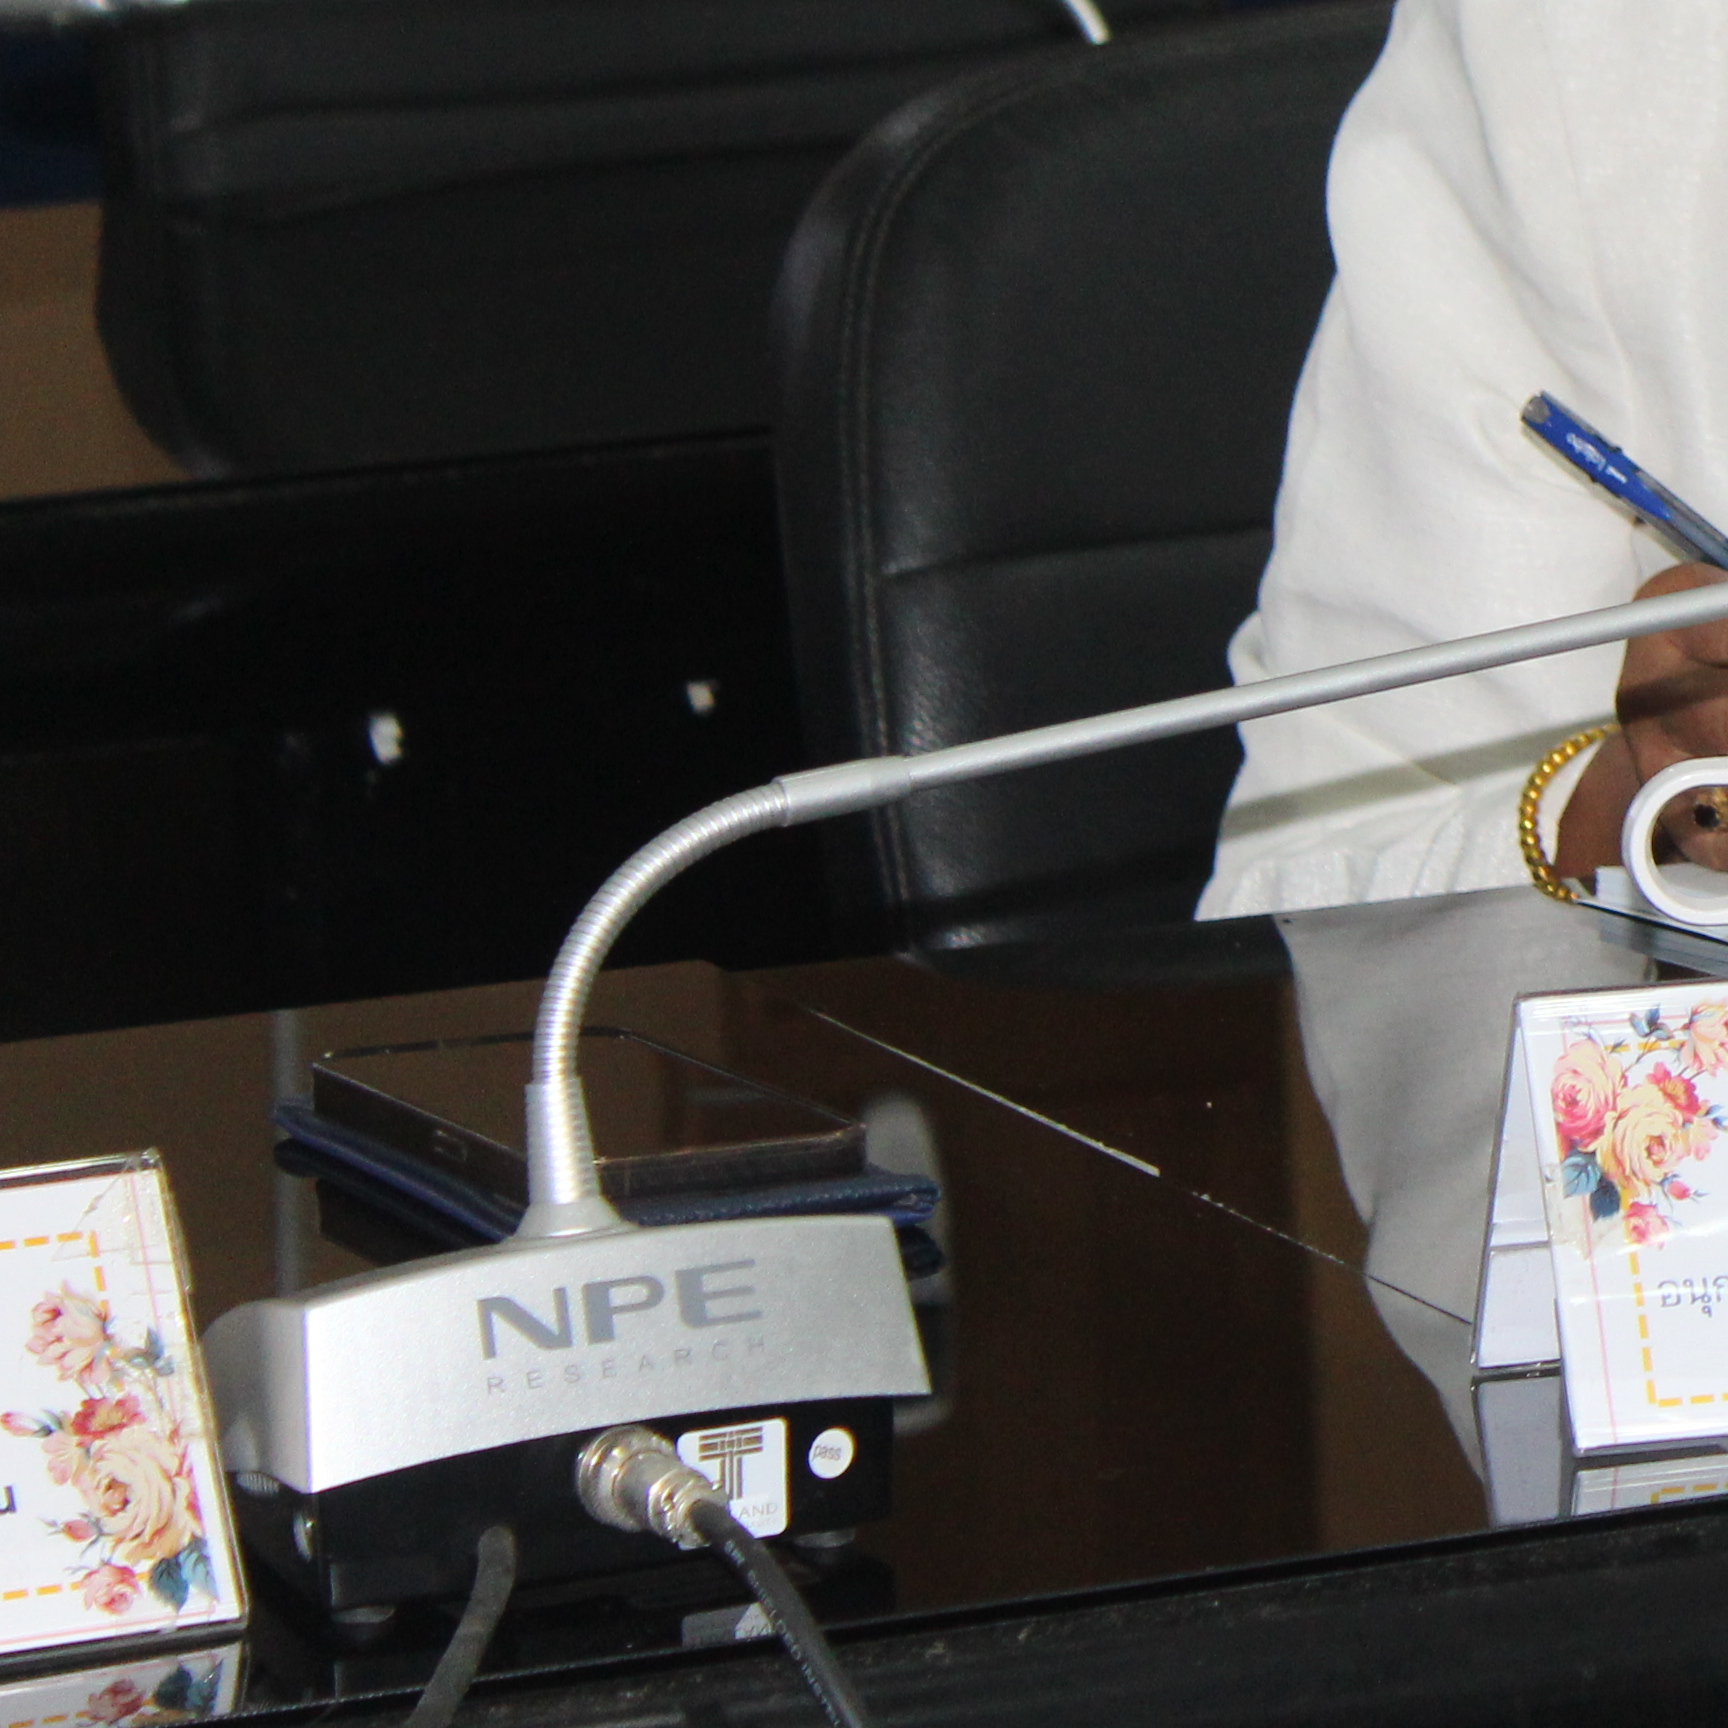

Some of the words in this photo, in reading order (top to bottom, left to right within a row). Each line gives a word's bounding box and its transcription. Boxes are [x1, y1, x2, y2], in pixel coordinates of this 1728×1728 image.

[476, 1258, 764, 1361] NPE
[486, 1335, 766, 1395] RESEARCH
[812, 1444, 842, 1463] pass
